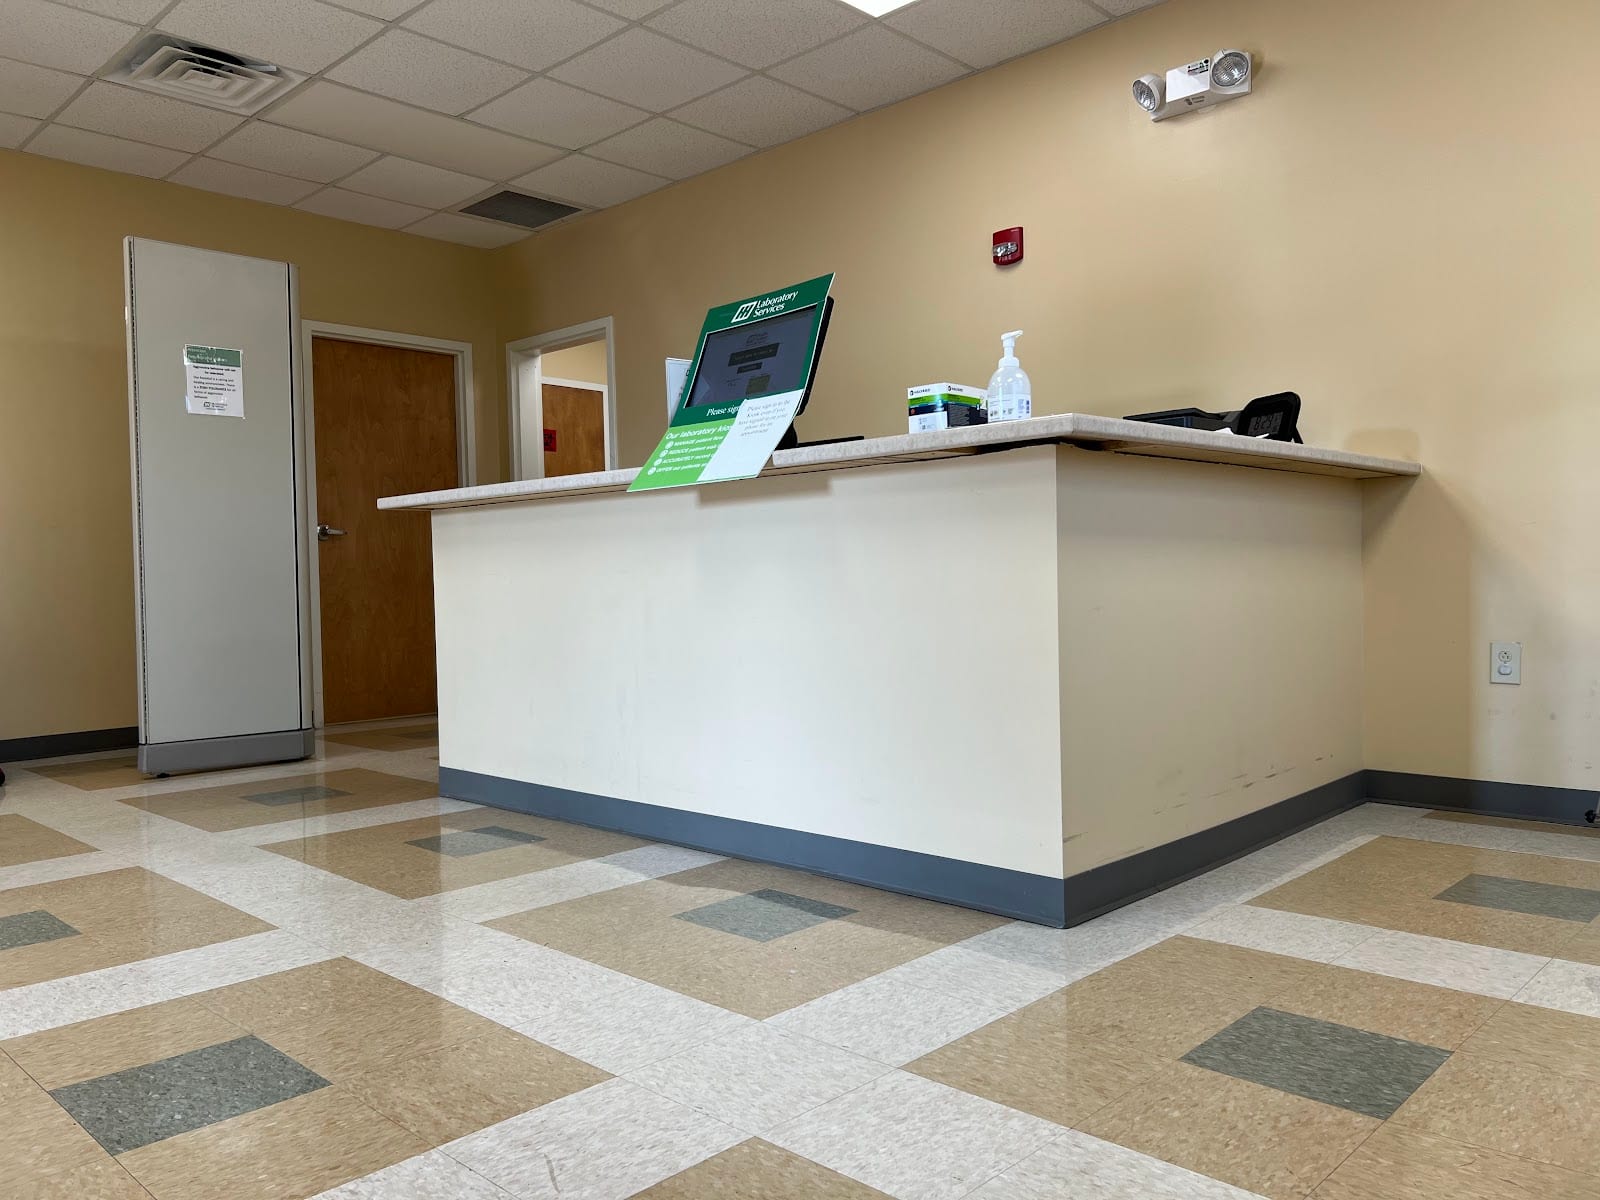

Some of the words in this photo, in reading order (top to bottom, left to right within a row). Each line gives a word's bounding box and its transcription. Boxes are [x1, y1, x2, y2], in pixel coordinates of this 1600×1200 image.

[756, 291, 799, 309] Laboratory
[753, 303, 786, 318] Services
[706, 408, 727, 417] Please
[666, 432, 680, 441] Our
[680, 428, 716, 438] laboratory
